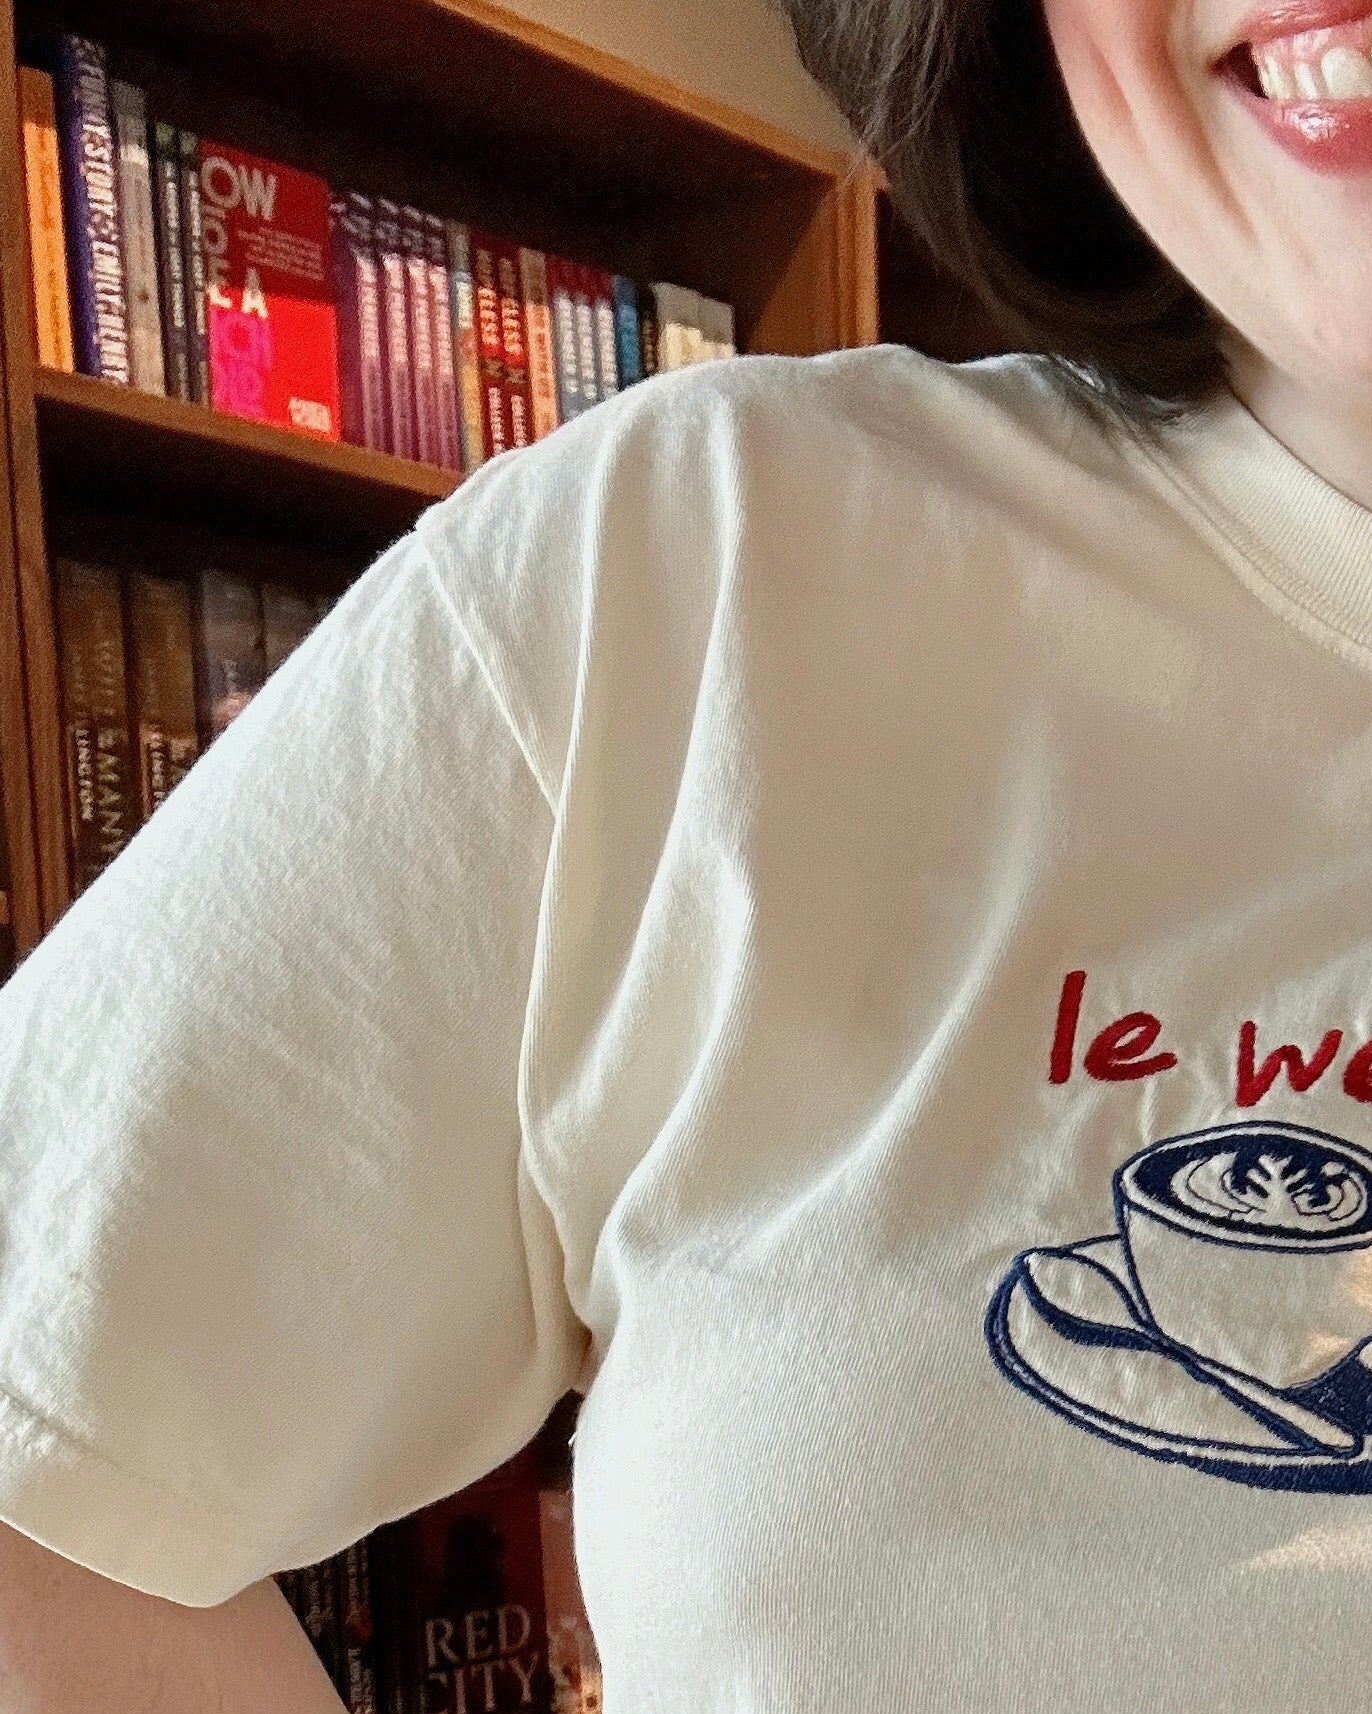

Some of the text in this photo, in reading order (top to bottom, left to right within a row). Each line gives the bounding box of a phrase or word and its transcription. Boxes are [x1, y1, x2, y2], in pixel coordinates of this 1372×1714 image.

[83, 142, 117, 217] STORY
[91, 240, 129, 383] EMILY HENRY
[1049, 969, 1177, 1084] le
[425, 1604, 532, 1669] RED
